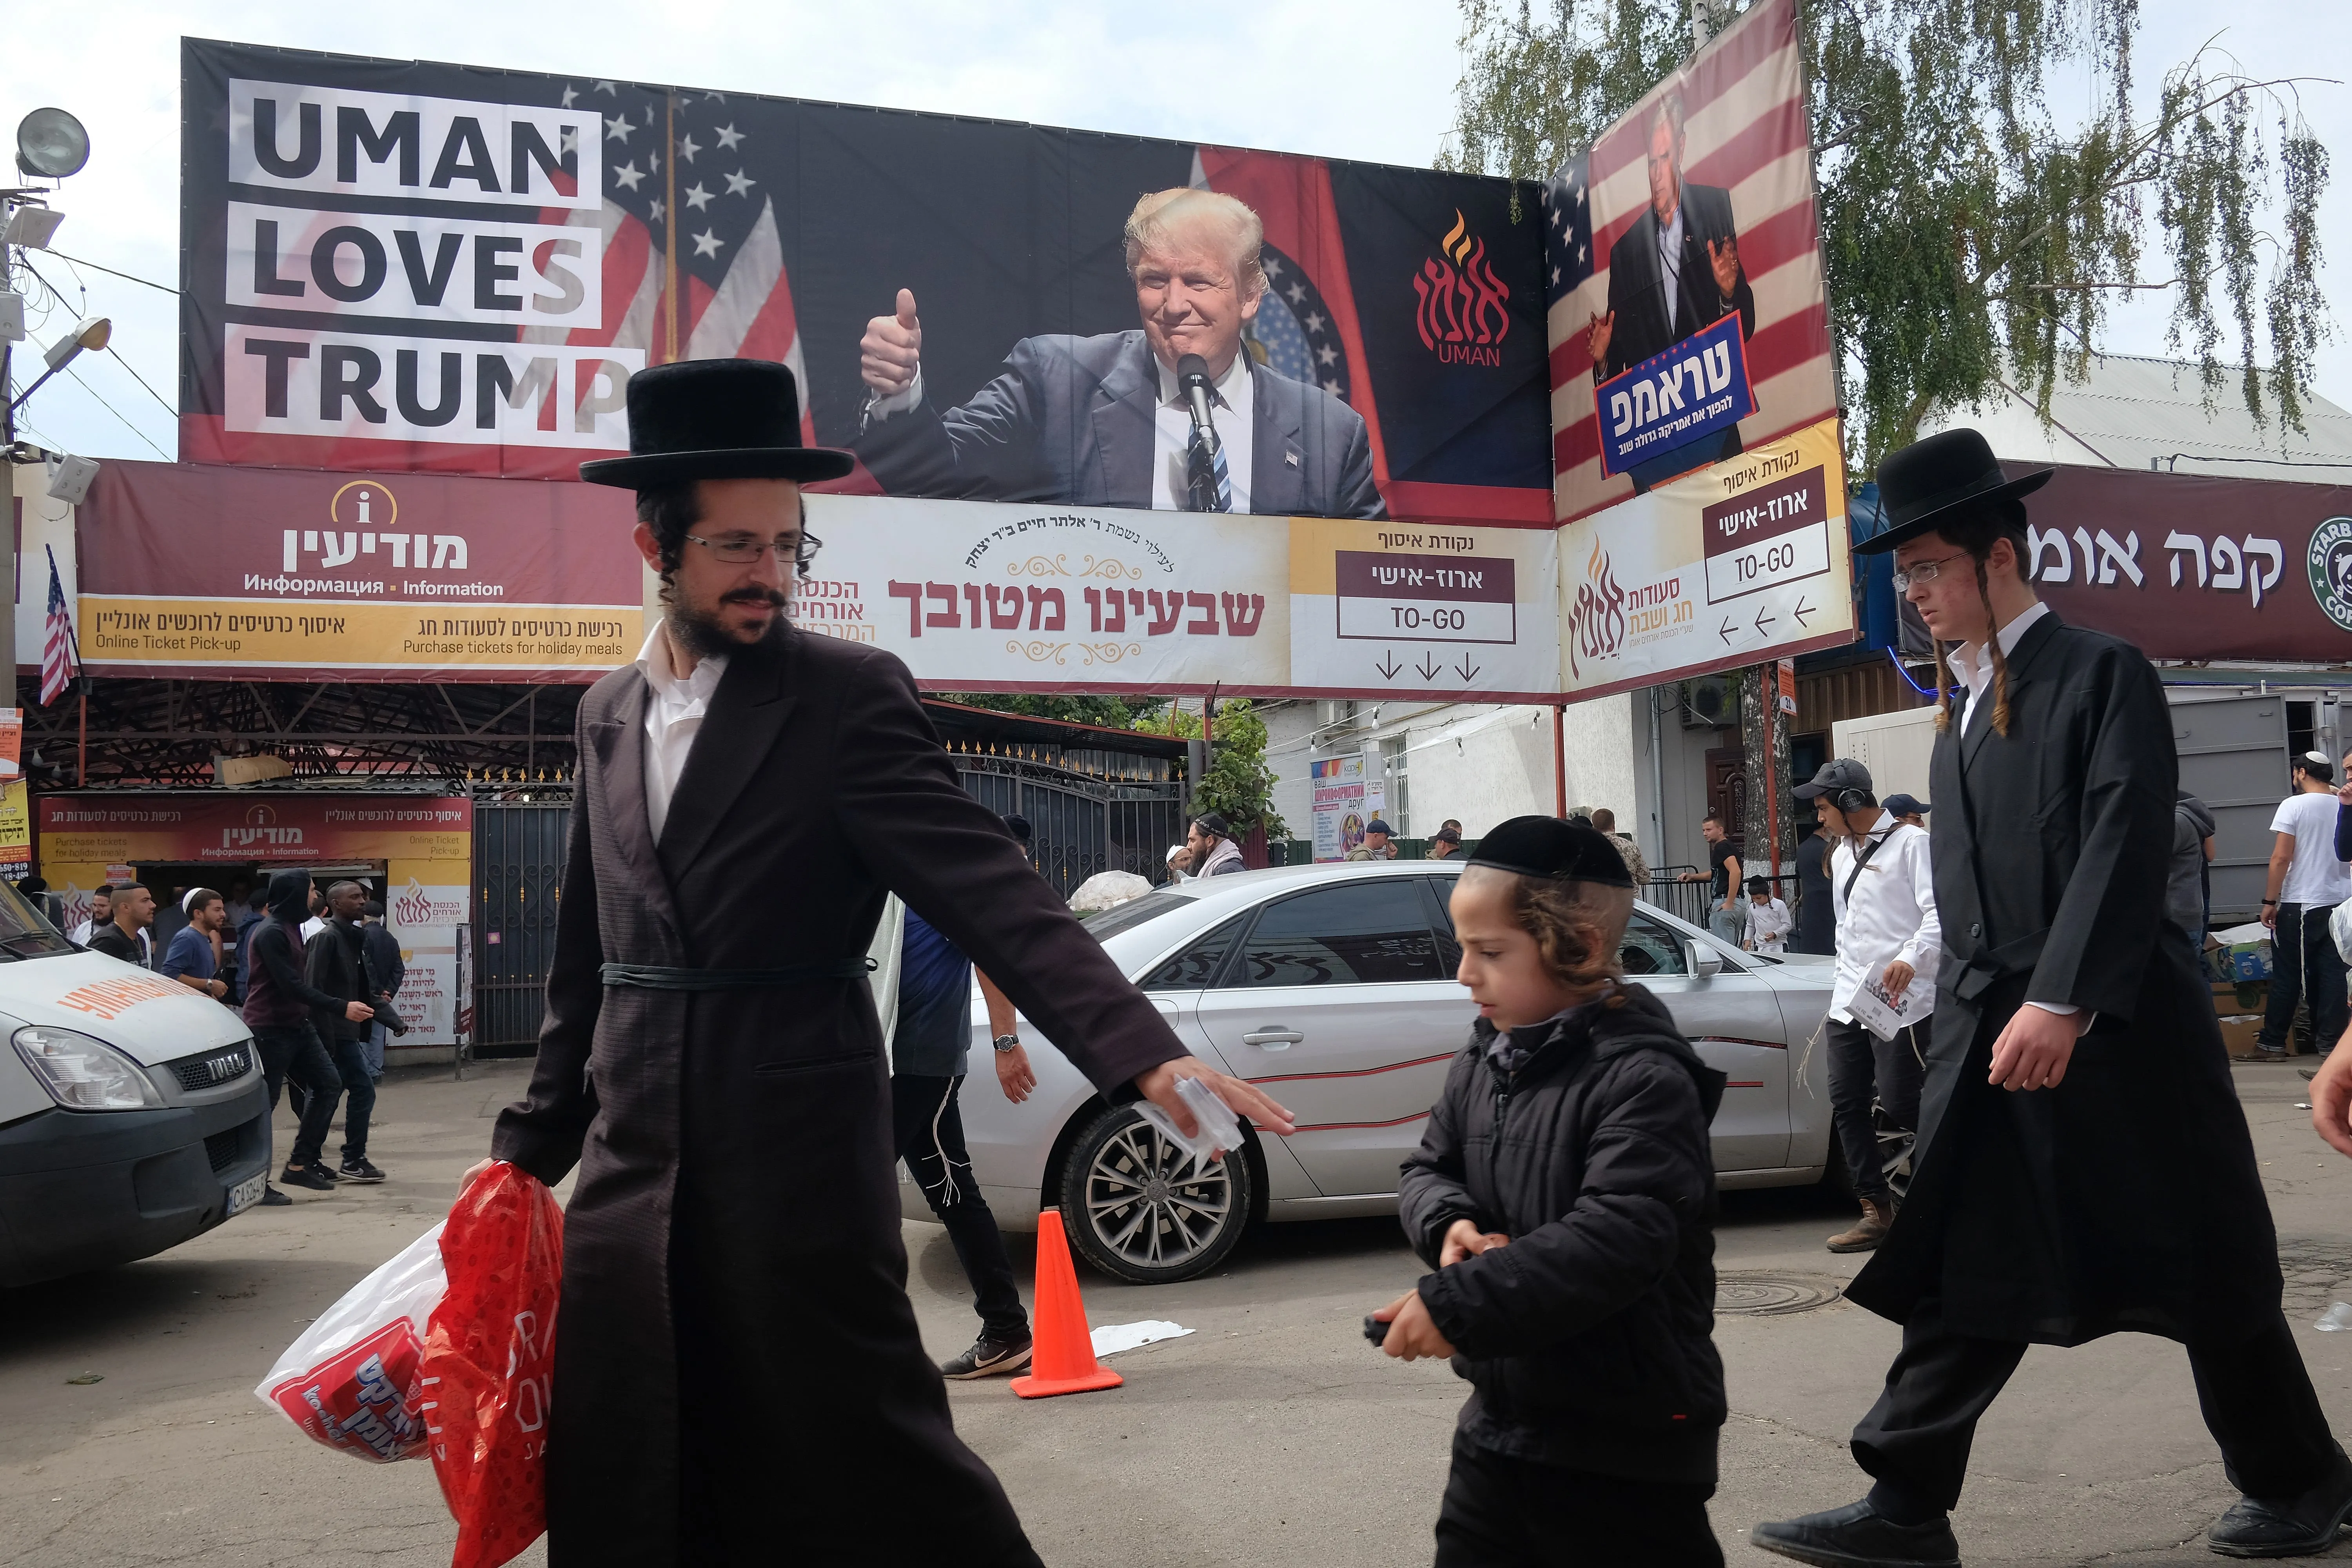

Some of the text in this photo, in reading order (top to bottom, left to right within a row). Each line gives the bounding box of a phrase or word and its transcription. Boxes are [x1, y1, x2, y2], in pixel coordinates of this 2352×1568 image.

[253, 98, 579, 197] UMAN
[254, 219, 585, 315] LOVES
[1438, 343, 1501, 367] UMAN
[244, 338, 630, 434] TRUMP
[1610, 339, 1731, 438] טראמפ
[1618, 394, 1733, 456] להפוך את אמריקה גדולה שוב
[1723, 448, 1799, 494] נקודת איסוף
[1049, 514, 1086, 528] אלתר
[1718, 488, 1808, 537] ארוז-אישי
[1016, 516, 1046, 533] חיים
[1105, 522, 1141, 544] נשמת
[283, 529, 468, 572] מודיעין
[965, 537, 991, 569] יצחק
[1378, 532, 1474, 552] נקודת איסוף
[2311, 523, 2352, 568] STARB
[1145, 539, 1174, 573] לעילוי
[1734, 542, 1794, 582] TO-GO
[2027, 523, 2283, 609] קפה אומ
[244, 573, 504, 596] Информация Information
[1372, 566, 1483, 589] ארוז-אישי
[1628, 577, 1680, 611] סעודות
[887, 578, 1265, 638] שבעינו מטובך
[1391, 607, 1465, 630] TO-GO
[1629, 600, 1693, 635] חג ושבת
[2325, 596, 2352, 624] COF
[96, 610, 345, 637] איסוף כרטיסים לרוכשים אונליין
[418, 617, 623, 638] רכישת כרטיסים לסעודות חג
[1661, 628, 1679, 639] הכנסת
[96, 634, 241, 653] Online Ticket Pick-up
[404, 640, 623, 658] Purchase tickets for holiday meals
[1629, 638, 1640, 648] אומן
[1642, 633, 1659, 644] אורחים
[1314, 780, 1326, 789] ваш
[1348, 798, 1364, 810] друг
[1846, 797, 1861, 808] JBL
[51, 809, 181, 822] רכישת כרטיסים לסעודות חג
[325, 809, 462, 823] איסוף כרטיסים לרוכשים אונליין
[55, 838, 127, 846] Purchase tickets
[223, 827, 303, 848] מודיעין
[410, 836, 459, 845] Online Ticket
[55, 849, 126, 858] for holiday meals
[201, 847, 319, 857] Информация Information
[431, 847, 459, 857] Pick-up
[205, 1053, 244, 1080] IVECO
[301, 1384, 350, 1443] kosher
